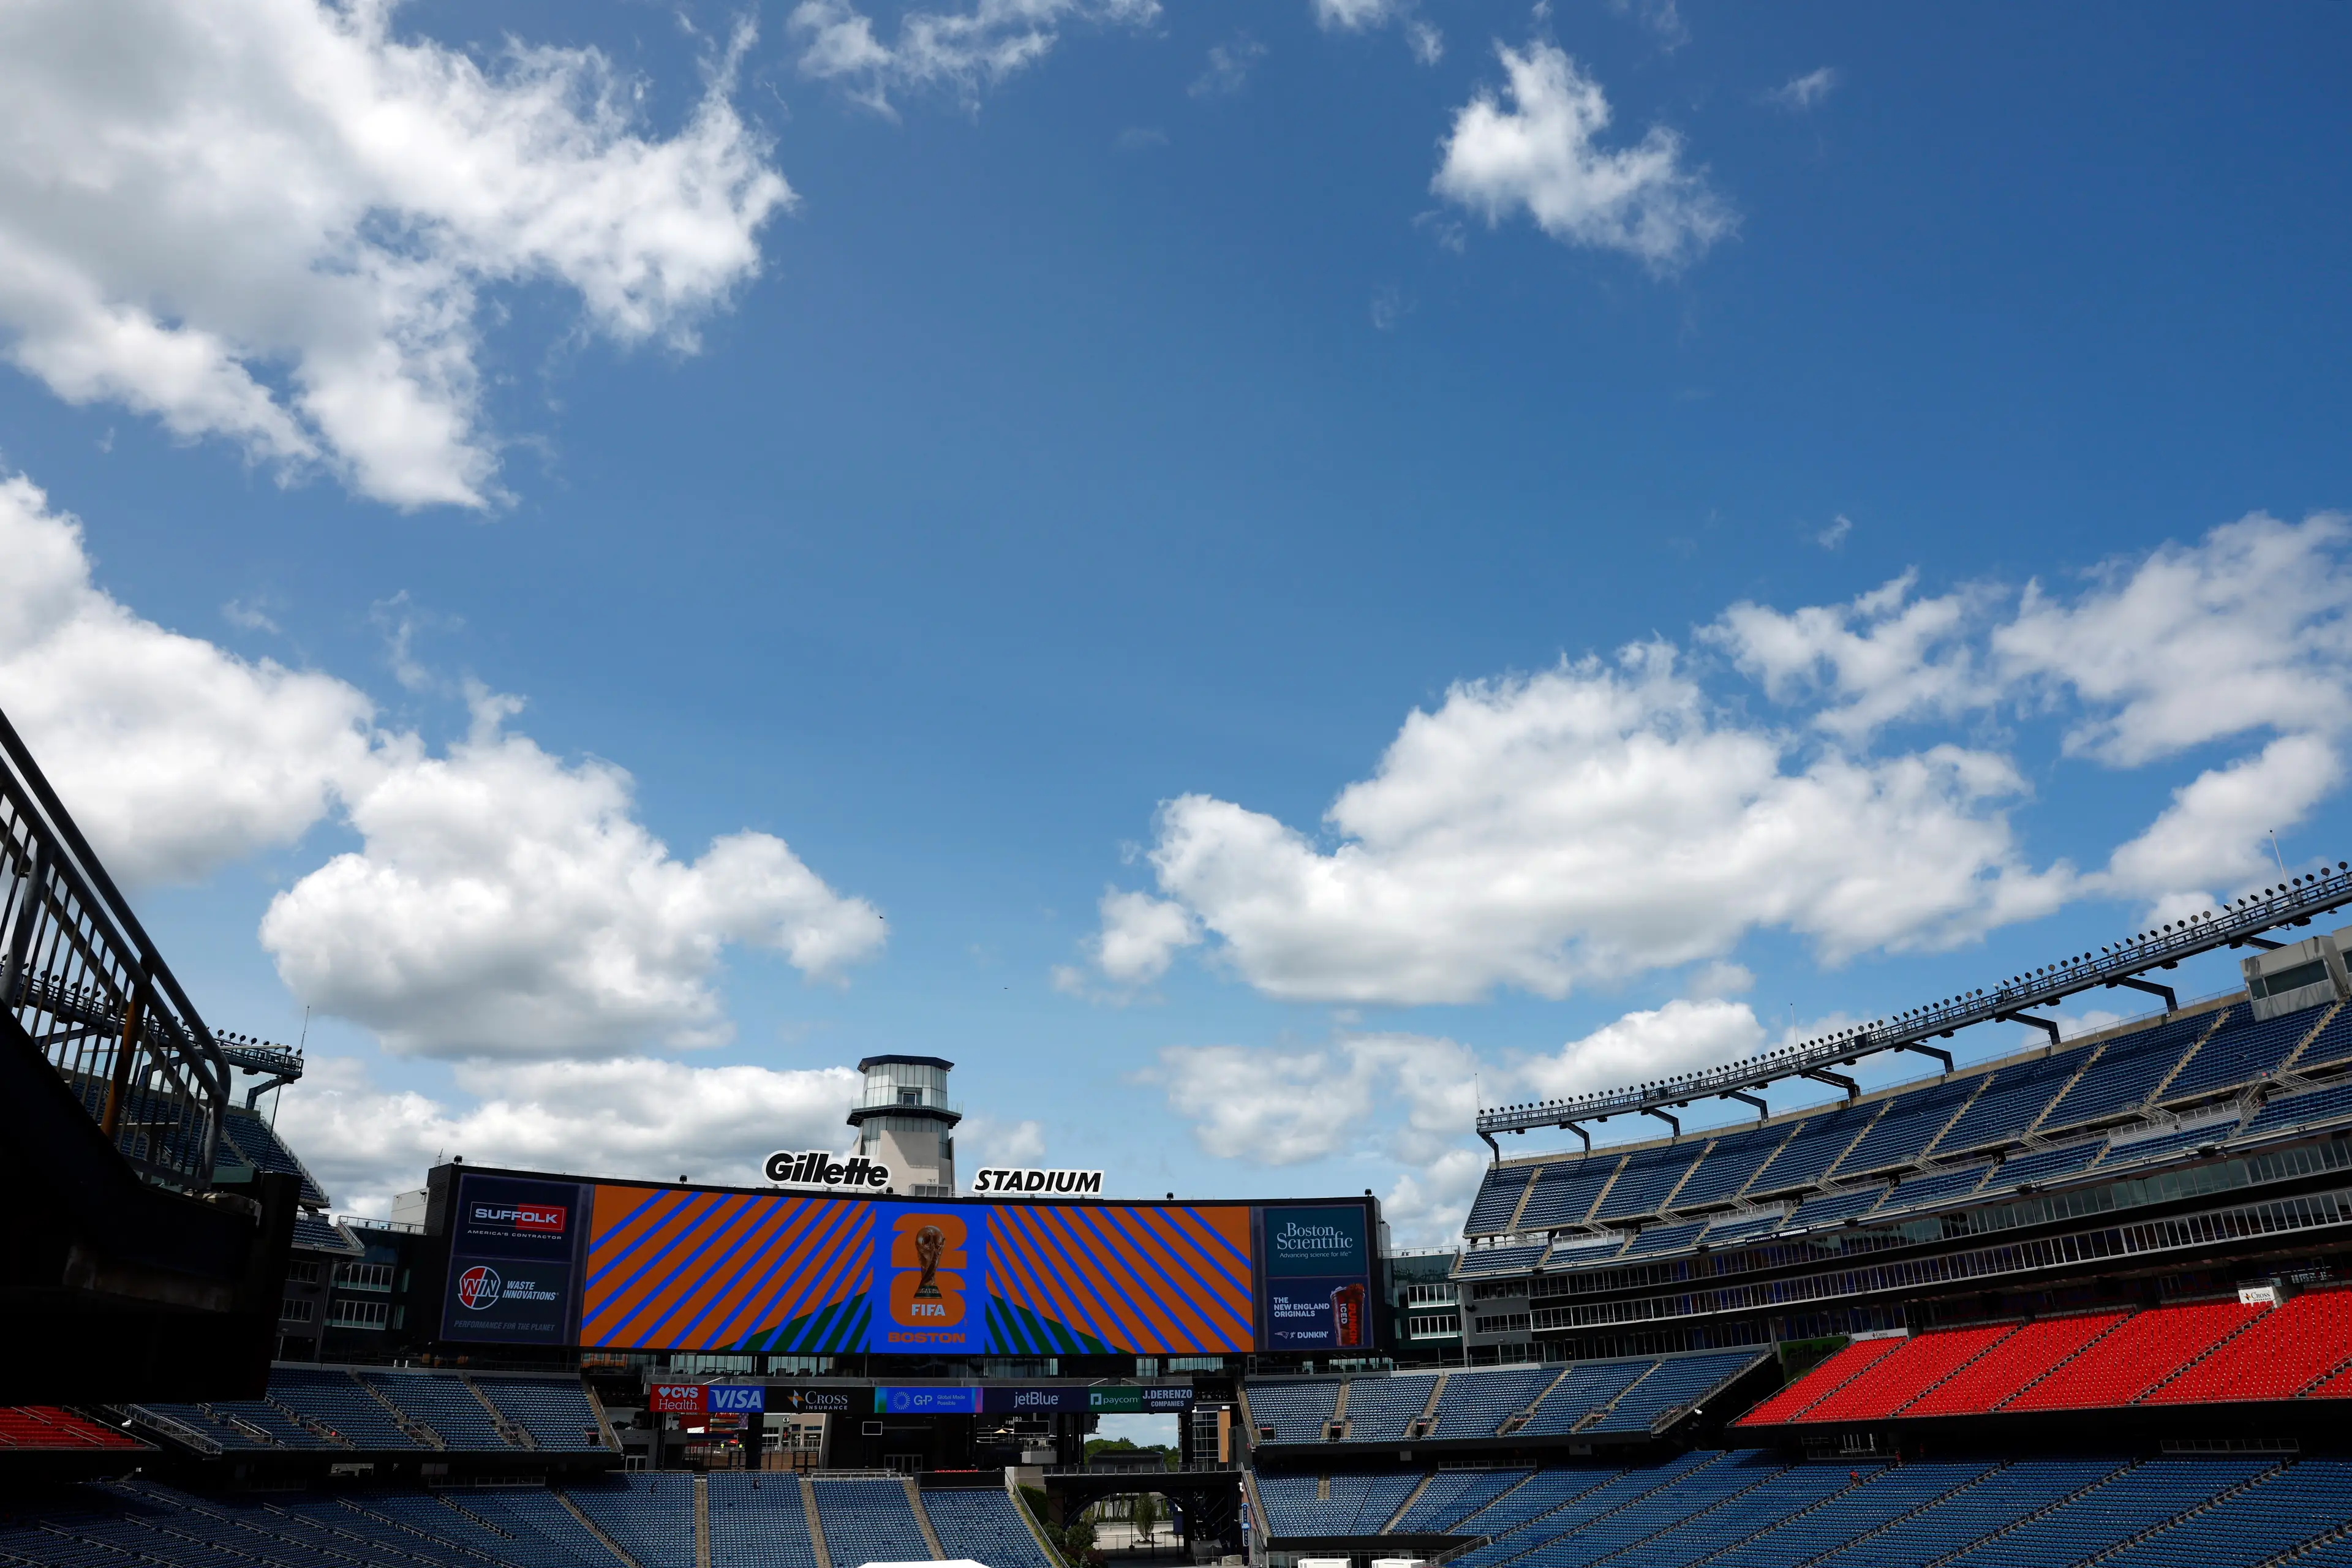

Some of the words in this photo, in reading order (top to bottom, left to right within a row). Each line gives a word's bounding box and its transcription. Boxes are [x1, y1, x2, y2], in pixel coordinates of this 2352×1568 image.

[766, 1153, 888, 1186] Gillette
[975, 1169, 1102, 1193] STADIUM
[475, 1208, 558, 1224] SUFFOLK
[1286, 1223, 1335, 1237] Boston
[1276, 1231, 1353, 1250] Scientific
[462, 1278, 497, 1297] WIN
[507, 1280, 535, 1290] WASTE
[502, 1290, 557, 1300] INNOVATIONS
[911, 1304, 946, 1316] FIFA
[454, 1320, 502, 1330] PERFORMANCE
[888, 1332, 965, 1343] BOSTON
[671, 1387, 698, 1398] CVS
[658, 1399, 697, 1410] Health
[710, 1390, 762, 1408] VISA
[1014, 1392, 1059, 1408] jetBlue
[1103, 1396, 1138, 1405] paycom
